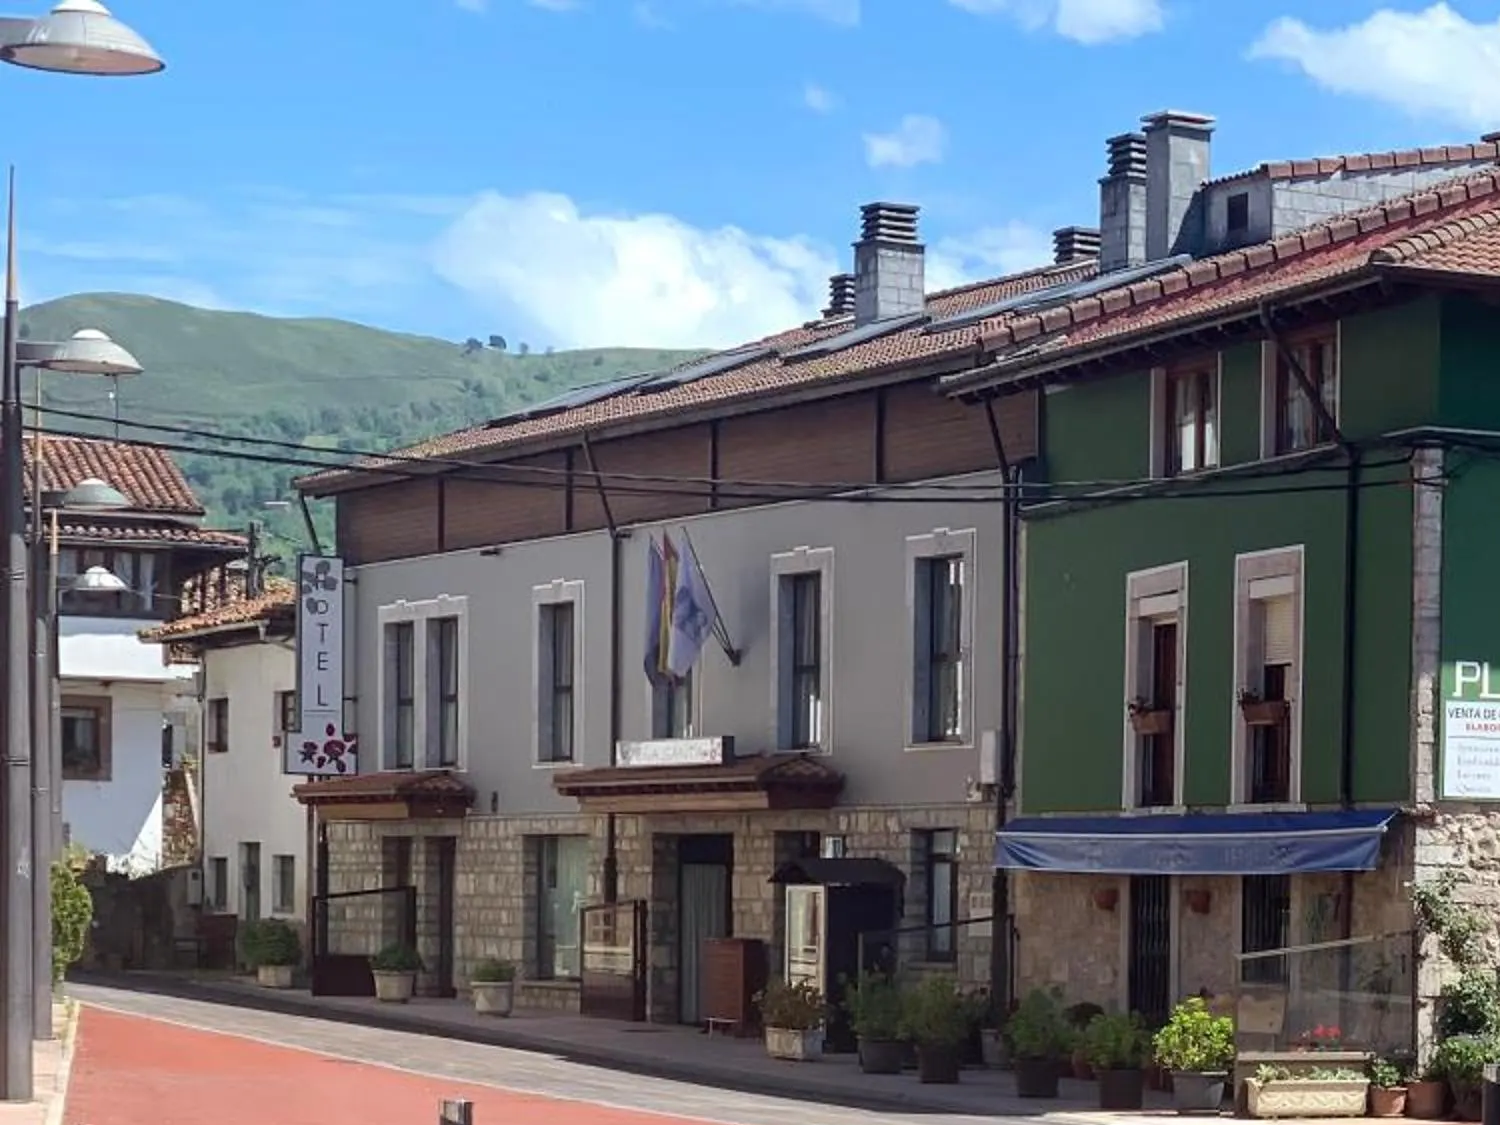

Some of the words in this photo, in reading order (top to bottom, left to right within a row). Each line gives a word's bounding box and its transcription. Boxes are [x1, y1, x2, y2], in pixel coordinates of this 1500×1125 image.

[314, 570, 330, 707] HOTEL
[1447, 707, 1482, 719] VENTA
[1484, 709, 1497, 720] DE
